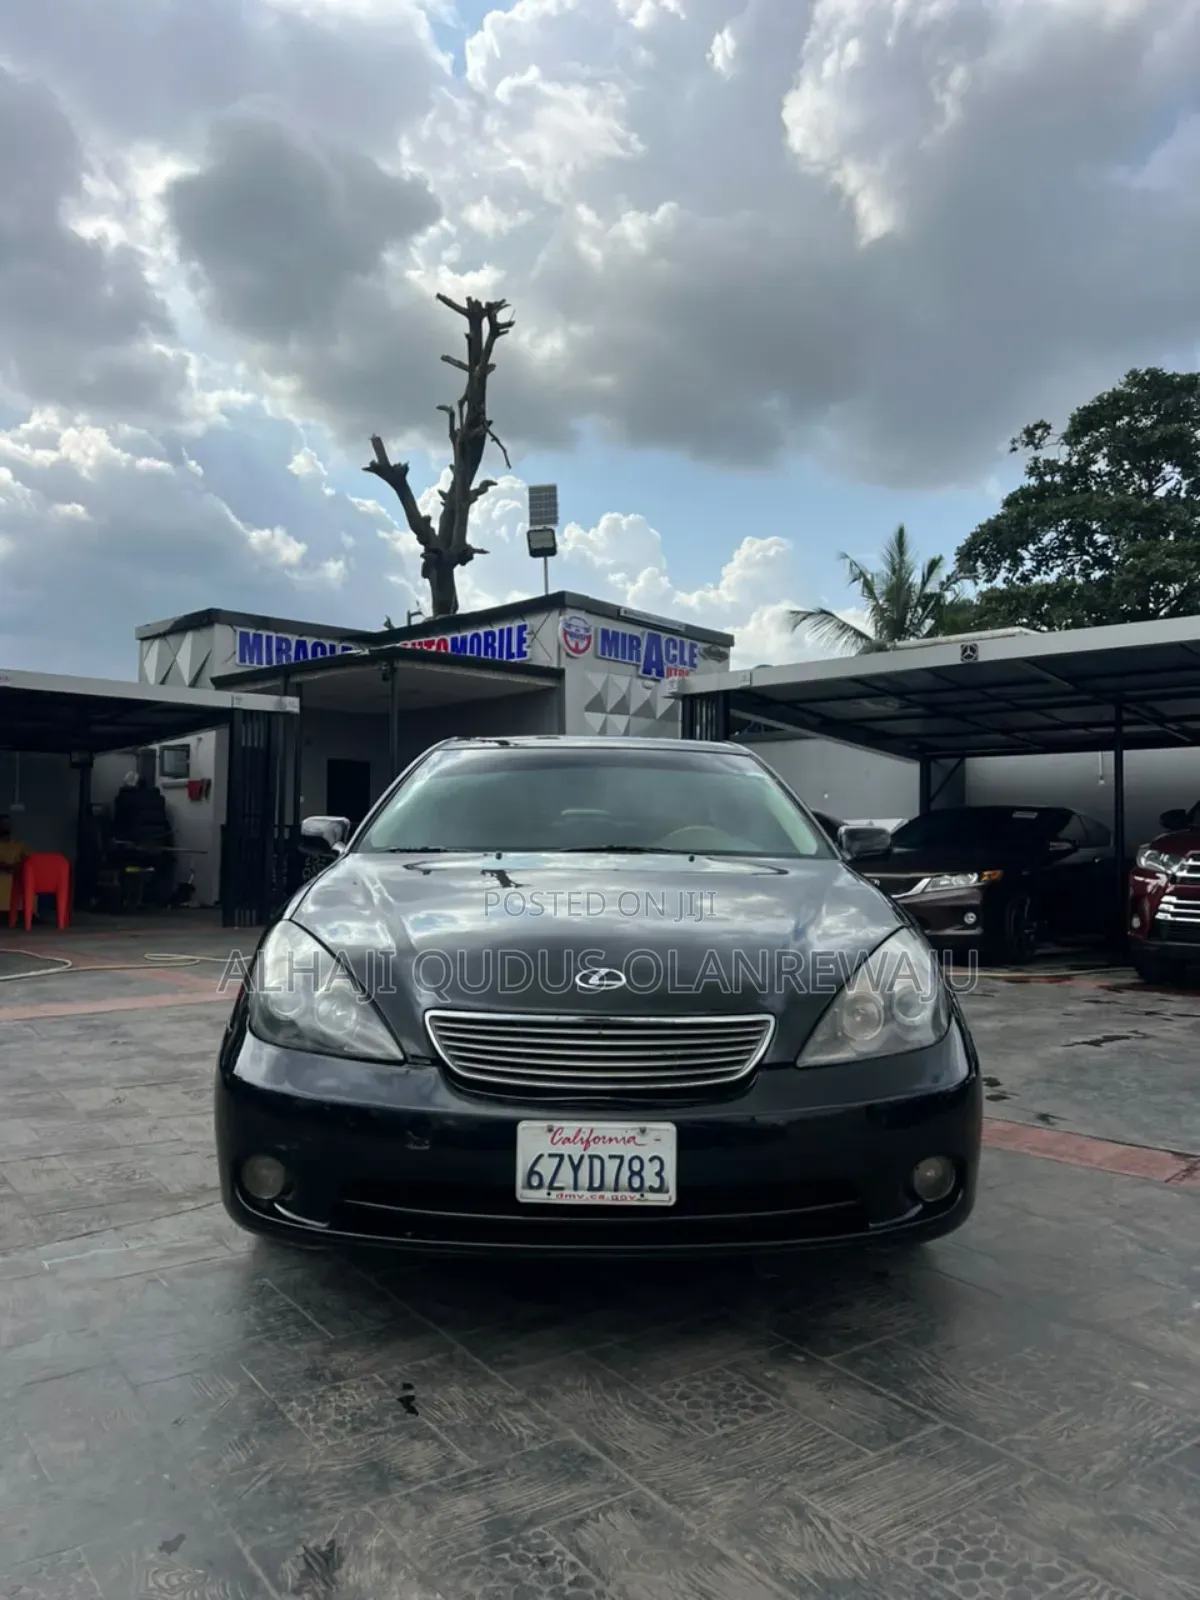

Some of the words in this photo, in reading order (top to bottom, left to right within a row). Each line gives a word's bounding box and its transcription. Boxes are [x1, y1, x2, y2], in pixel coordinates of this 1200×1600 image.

[238, 630, 354, 666] MIRAC
[600, 628, 698, 679] MIRACLE
[550, 1127, 648, 1152] California
[526, 1153, 666, 1193] 6ZYD783
[555, 1192, 637, 1201] dmv.ca.gov
